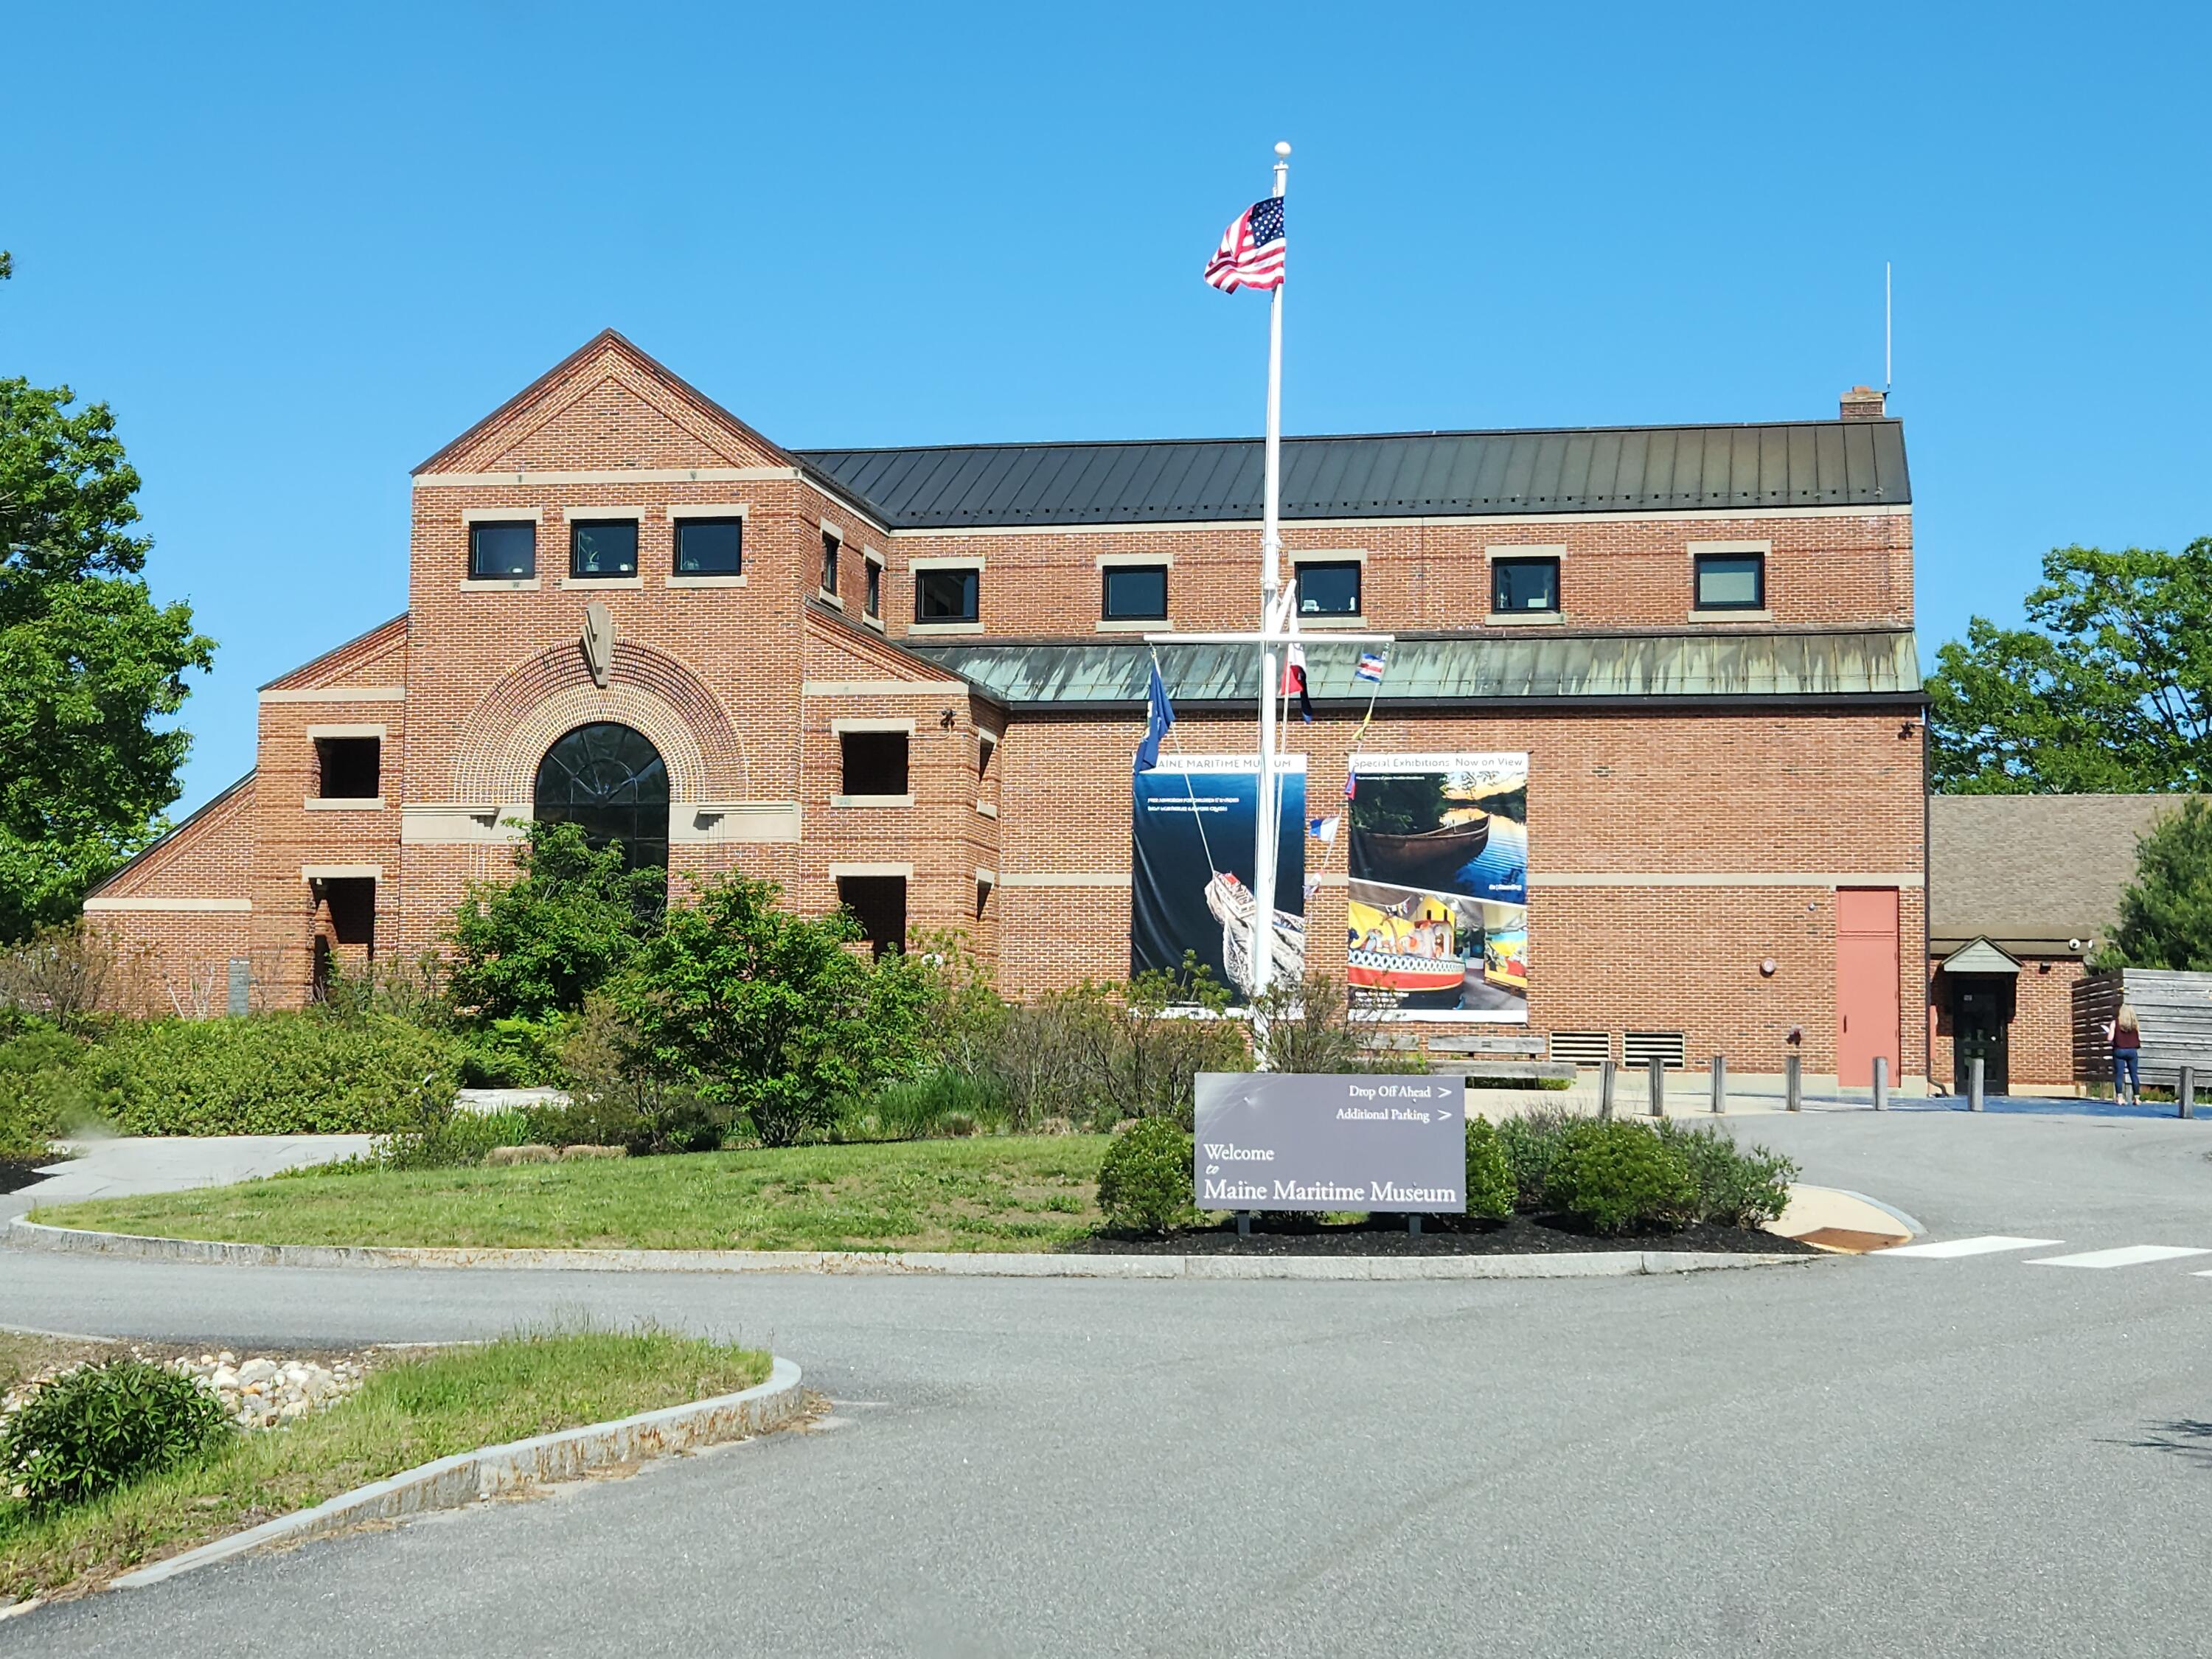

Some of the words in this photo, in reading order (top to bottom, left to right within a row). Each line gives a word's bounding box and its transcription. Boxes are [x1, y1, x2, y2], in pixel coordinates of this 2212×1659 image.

[1158, 759, 1183, 768] AINE
[1186, 759, 1239, 768] MARITIME
[1243, 759, 1291, 768] MUUM
[1354, 759, 1391, 768] Special
[1393, 759, 1450, 767] Exhibitions
[1455, 758, 1479, 767] Now
[1498, 758, 1523, 766] View
[1349, 1085, 1376, 1101] Drop
[1378, 1085, 1399, 1097] Off
[1398, 1085, 1432, 1098] Ahead
[1336, 1107, 1388, 1120] Additional
[1391, 1108, 1430, 1124] Parking
[1203, 1143, 1275, 1161] Welcome
[1205, 1164, 1220, 1175] to
[1203, 1179, 1267, 1200] Maine
[1273, 1180, 1365, 1201] Maritime
[1369, 1180, 1457, 1203] Museum
